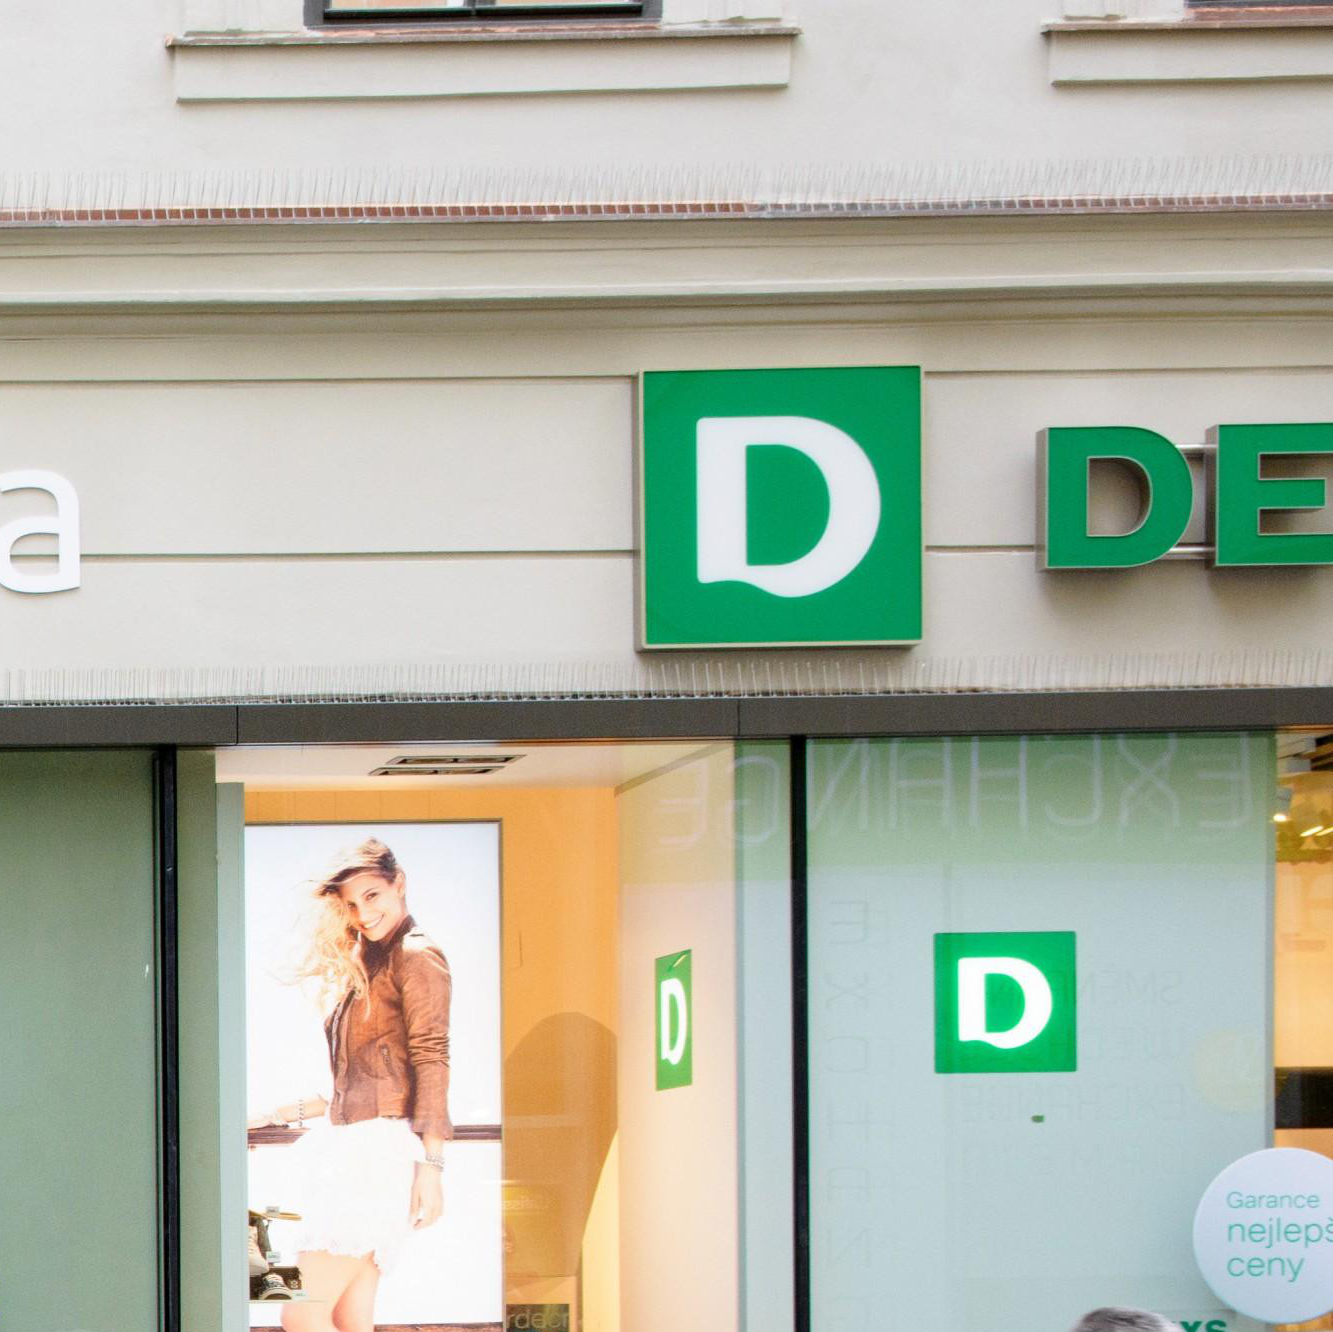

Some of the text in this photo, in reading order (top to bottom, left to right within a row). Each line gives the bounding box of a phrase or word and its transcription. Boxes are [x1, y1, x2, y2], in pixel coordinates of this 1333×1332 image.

[696, 415, 882, 598] D
[1037, 422, 1333, 570] DE
[957, 955, 1054, 1050] D
[1226, 1191, 1320, 1209] Garance
[1226, 1256, 1306, 1283] ceny
